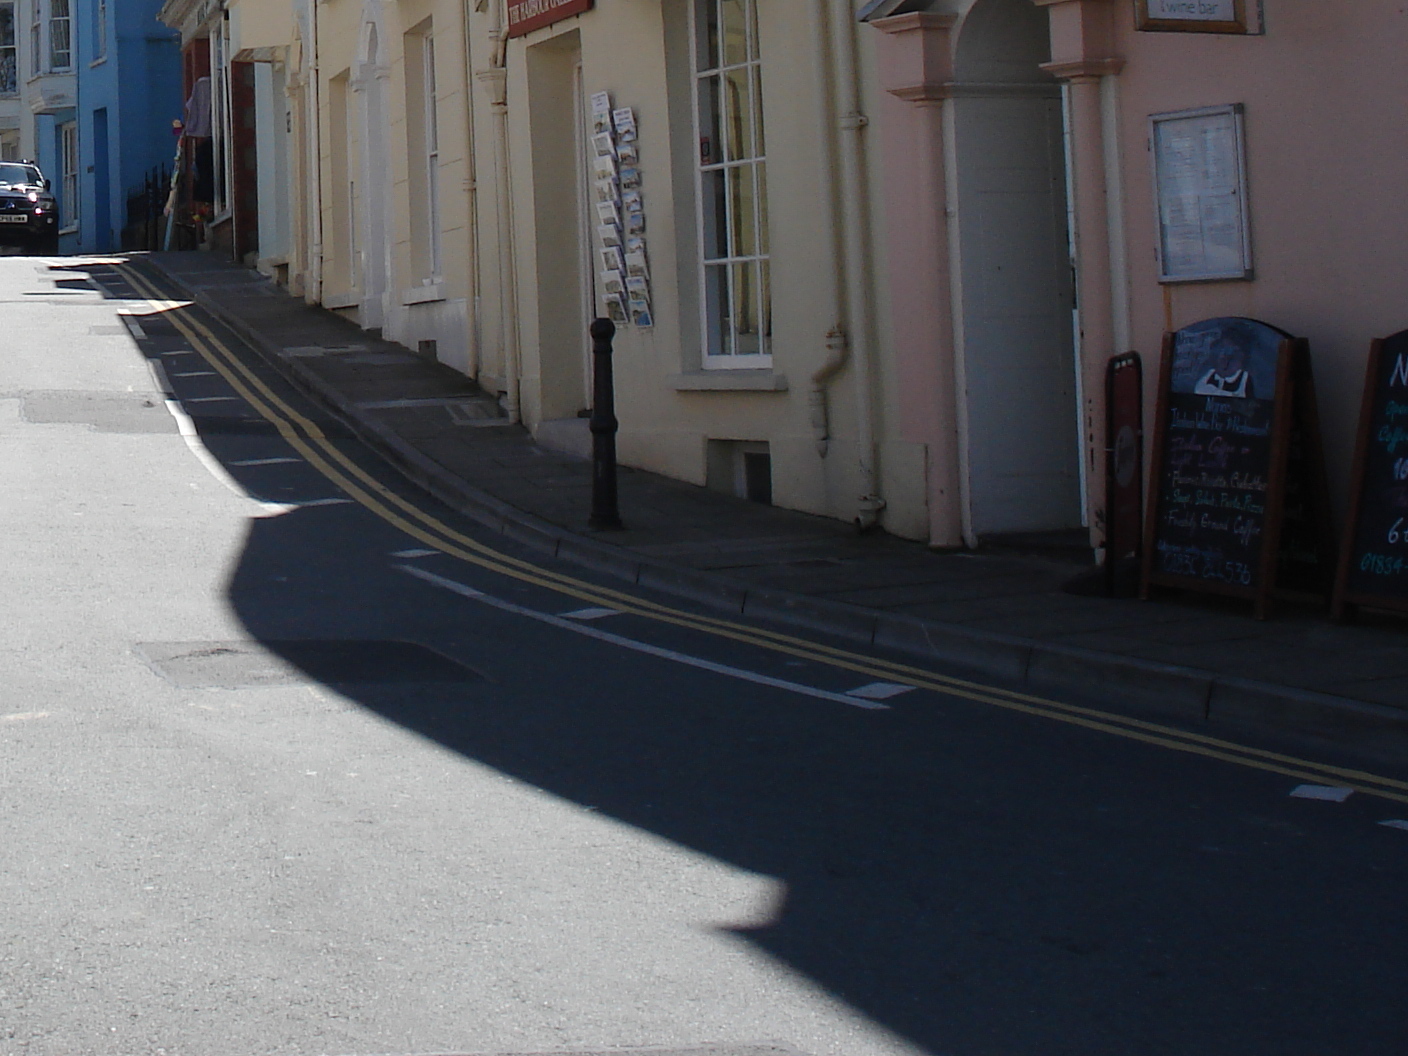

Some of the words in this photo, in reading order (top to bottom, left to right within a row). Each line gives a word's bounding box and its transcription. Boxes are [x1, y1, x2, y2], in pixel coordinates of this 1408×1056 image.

[508, 4, 521, 25] THE
[1166, 2, 1196, 15] wine
[1198, 0, 1219, 16] bar
